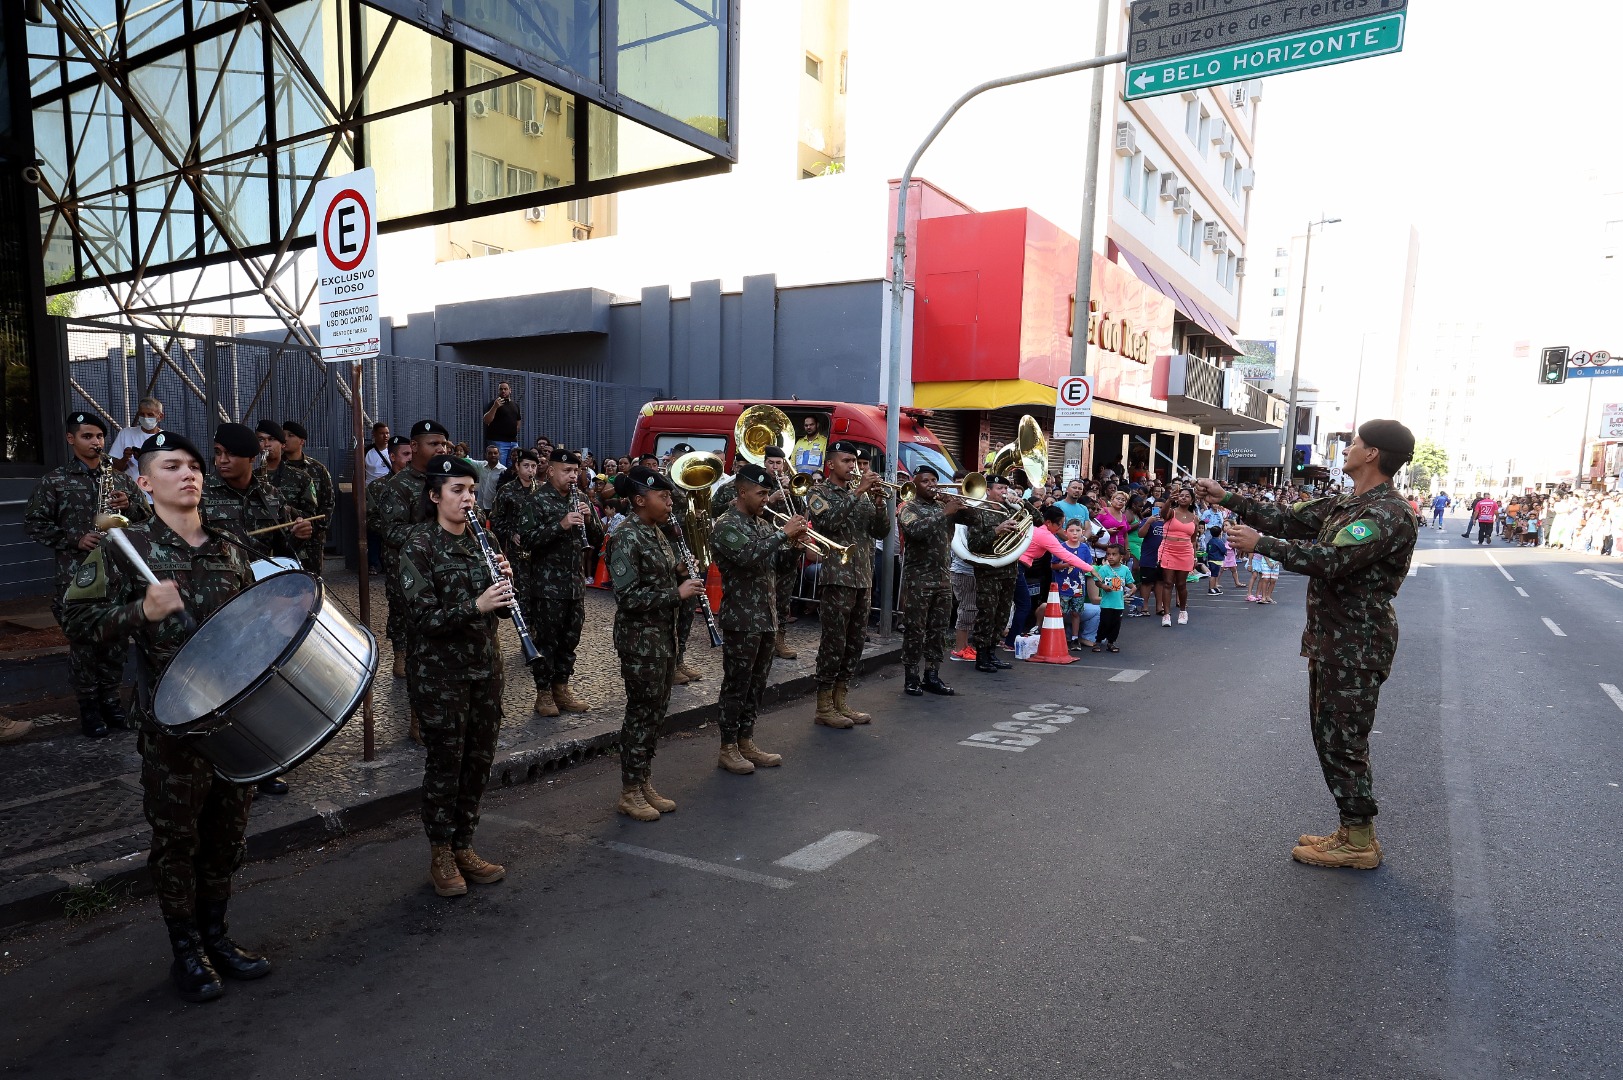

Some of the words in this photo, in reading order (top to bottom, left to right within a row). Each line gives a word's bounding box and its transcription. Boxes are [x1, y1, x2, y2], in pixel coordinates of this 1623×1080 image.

[1157, 20, 1239, 49] Luizote
[1248, 12, 1272, 30] de
[1283, 0, 1367, 23] Freitas
[1162, 60, 1221, 83] BELO
[1233, 27, 1380, 71] HORIZONTE
[338, 205, 357, 254] E
[321, 269, 375, 286] EXCLUSIVO
[334, 282, 364, 295] IDOSO
[326, 319, 339, 328] USO
[340, 317, 349, 326] DO
[1068, 383, 1082, 400] E
[665, 404, 692, 412] MINAS
[1481, 505, 1493, 515] 27
